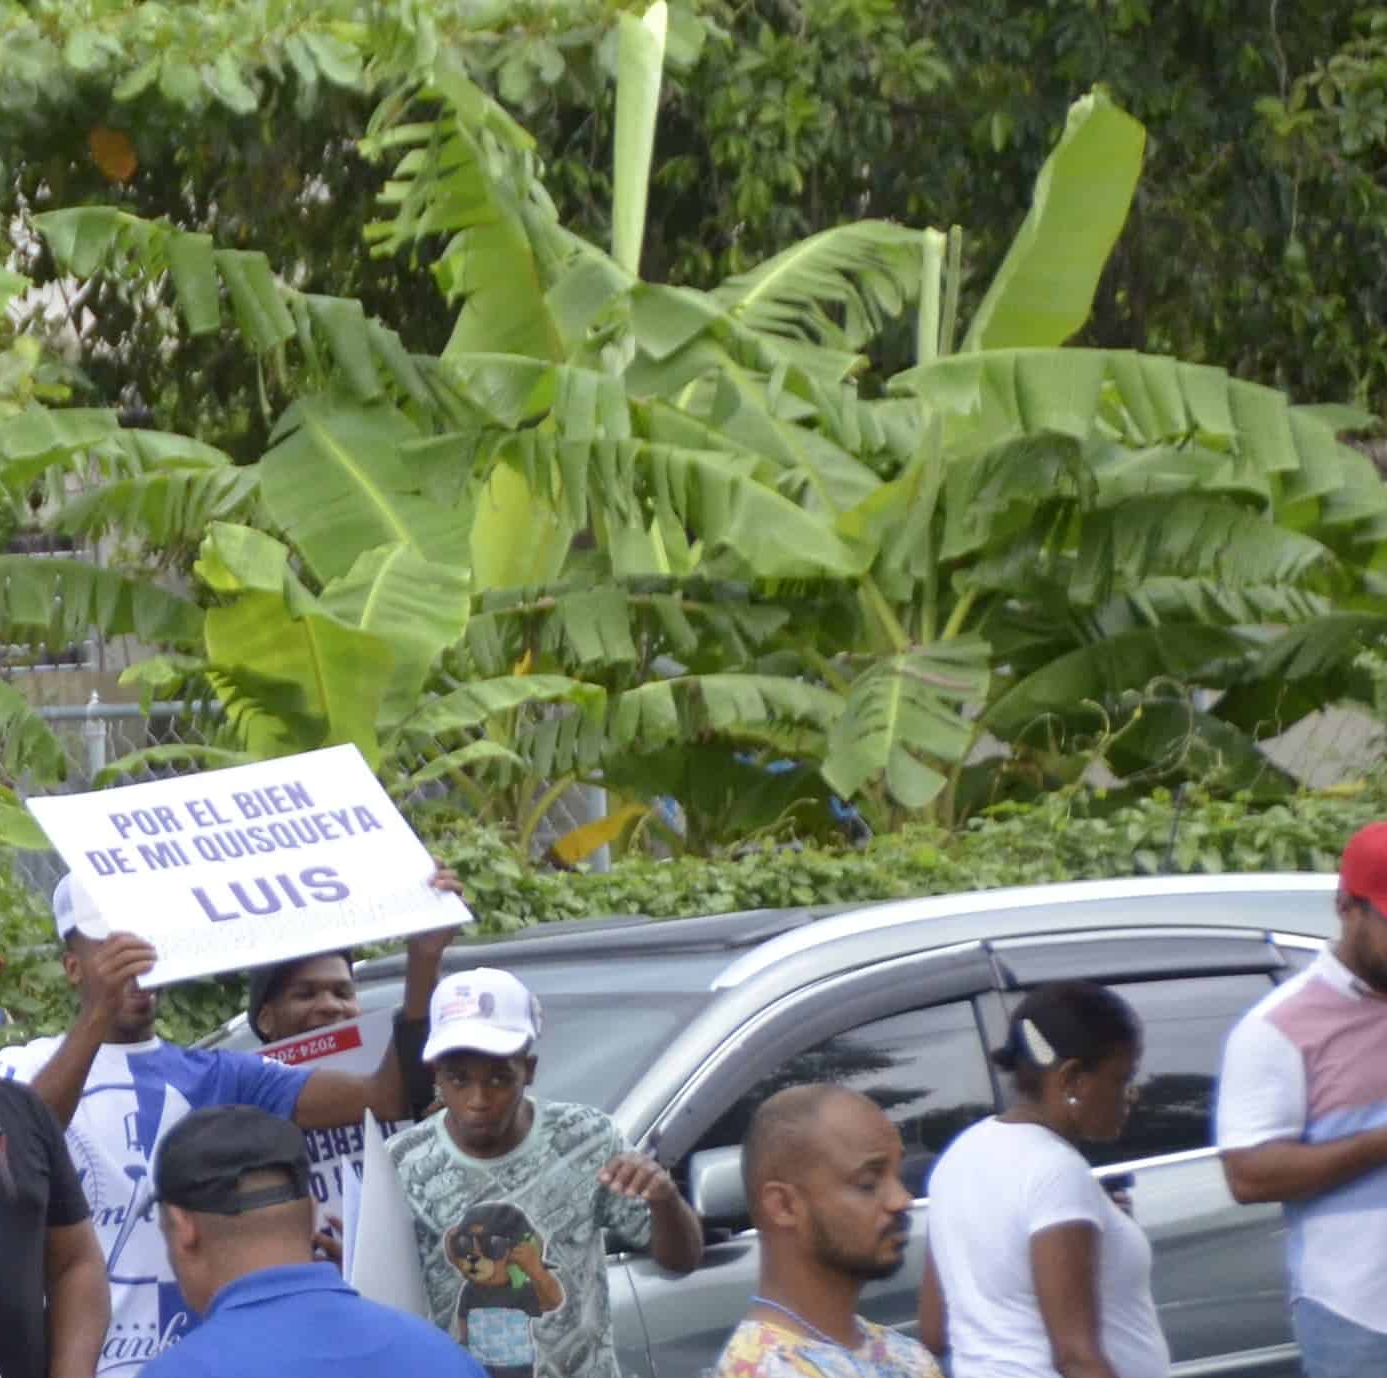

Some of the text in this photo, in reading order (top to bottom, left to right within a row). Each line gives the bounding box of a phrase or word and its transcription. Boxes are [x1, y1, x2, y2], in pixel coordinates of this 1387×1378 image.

[109, 780, 315, 840] POR EL BIEN
[85, 804, 384, 877] DE MI QUISQUEYA
[191, 865, 351, 923] LUIS
